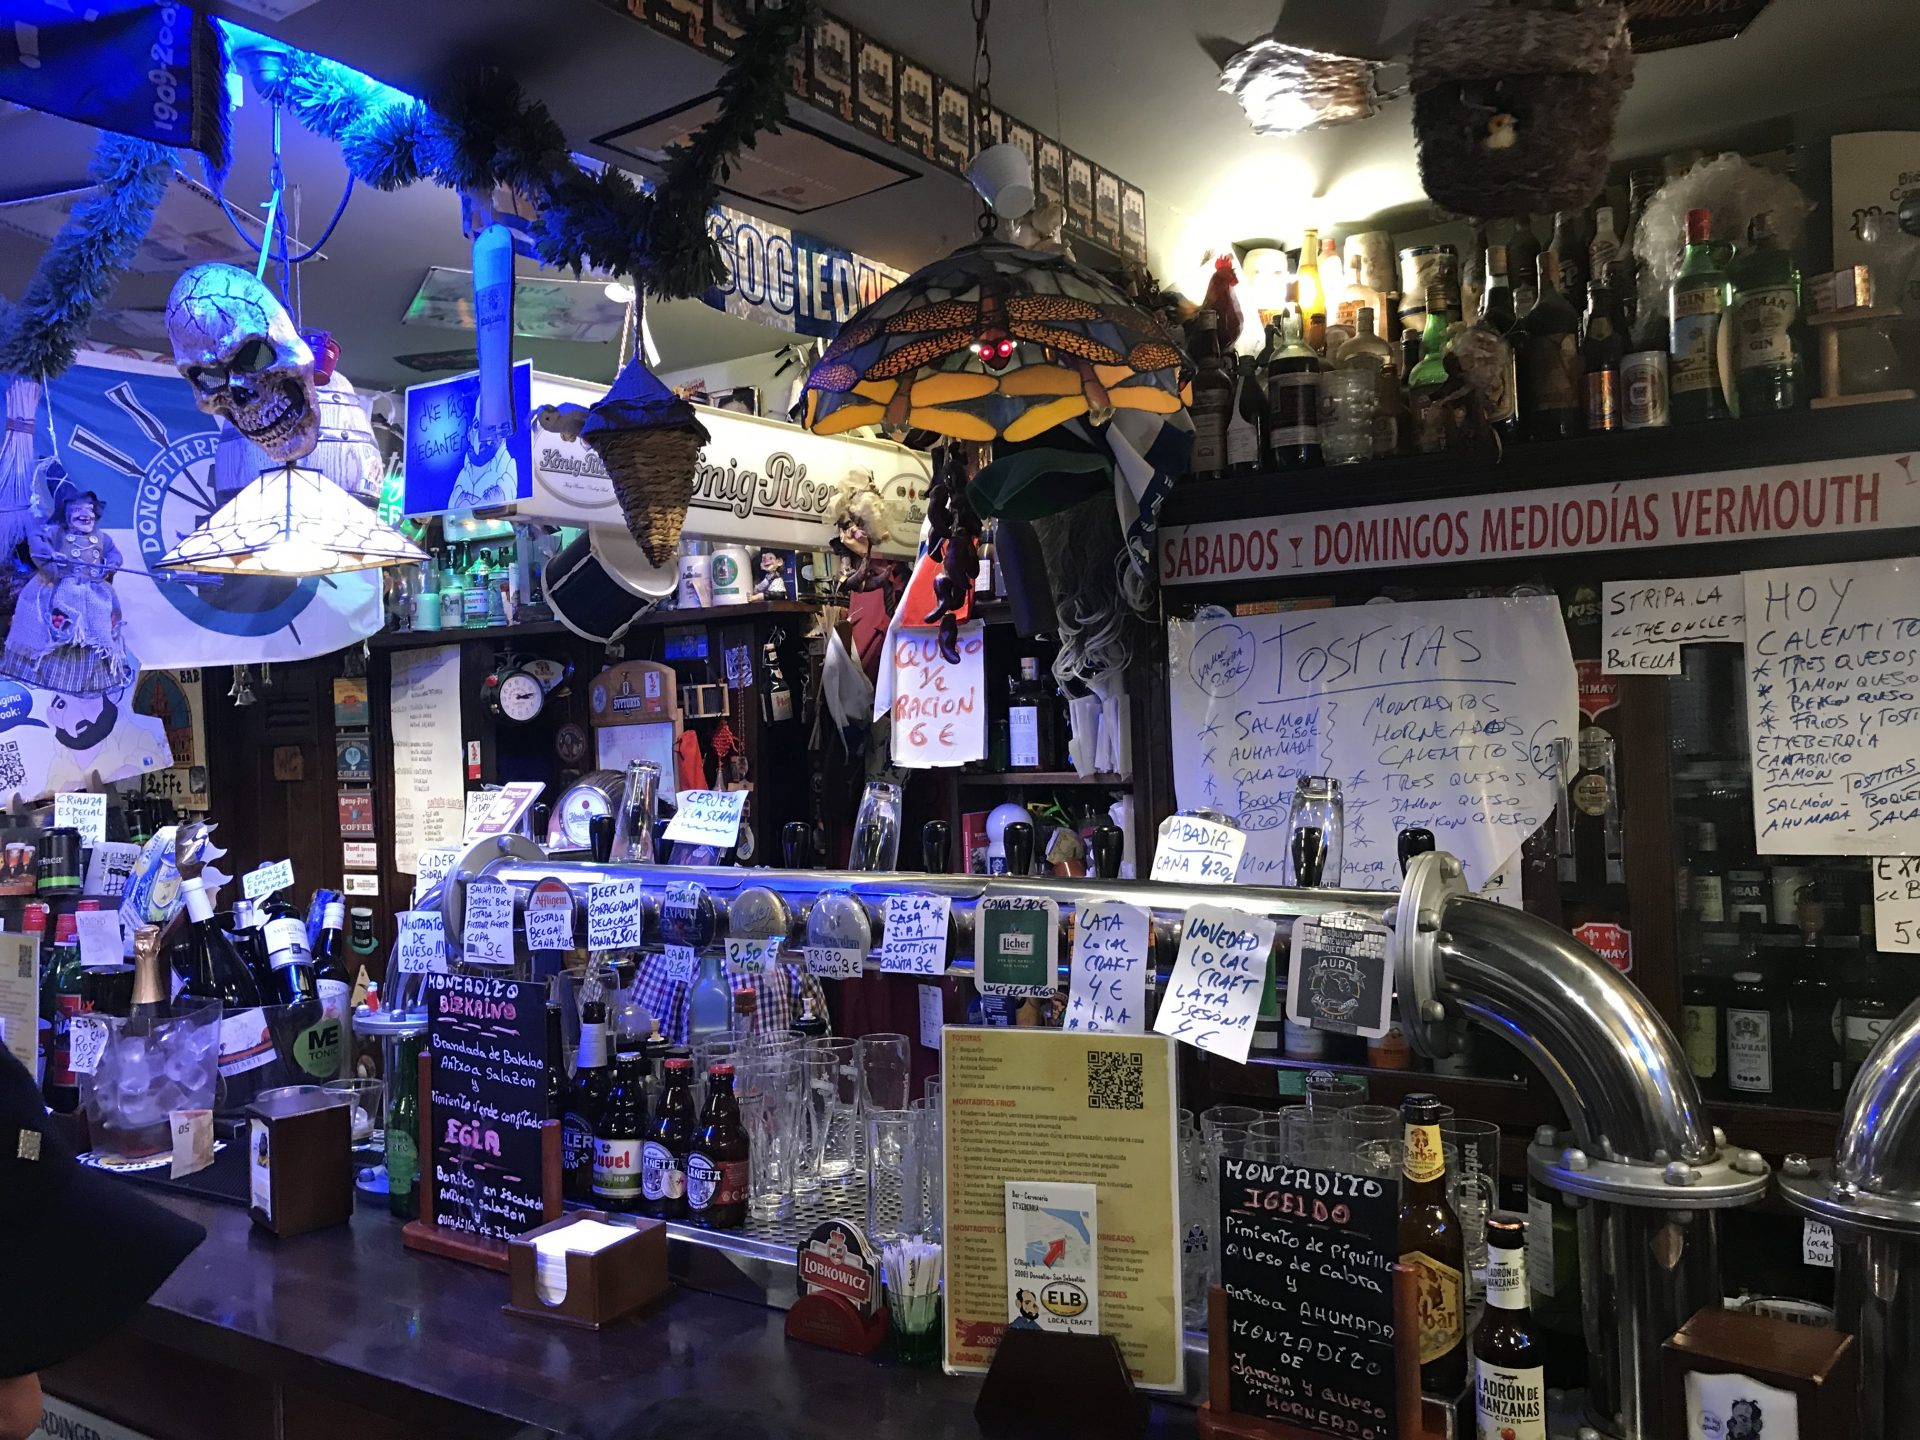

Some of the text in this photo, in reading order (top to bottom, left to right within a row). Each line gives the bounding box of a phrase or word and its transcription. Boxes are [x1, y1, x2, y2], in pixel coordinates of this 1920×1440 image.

[706, 213, 898, 322] SOCIEDA
[1164, 472, 1880, 579] SÁBADOS DOMINGOS MEDIODÍAS VERMOUTH
[1765, 577, 1854, 625] HOY
[1779, 650, 1918, 678] TRES QUESOS
[179, 671, 200, 684] BAR
[1857, 671, 1920, 687] QUESO
[147, 771, 183, 794] Leffe
[1383, 771, 1436, 792] TRES
[341, 823, 372, 831] COFFEE
[418, 854, 455, 867] CIDER
[470, 885, 508, 895] SALVATOR
[591, 885, 617, 903] BEER
[535, 895, 567, 907] Affligem
[890, 899, 930, 911] DE LA
[527, 912, 565, 925] TOSTADA
[889, 913, 921, 924] CASA
[1080, 909, 1124, 932] LATA
[412, 934, 425, 945] DE
[1186, 918, 1260, 952] NOVEDAD
[885, 942, 937, 955] SCOTTISH
[1003, 937, 1030, 951] Licher
[808, 949, 841, 962] TRIGO
[1320, 957, 1353, 971] AUPA
[1176, 984, 1229, 1008] LATA
[308, 1025, 340, 1049] ME
[433, 1033, 544, 1070] Brandada de Bakalao
[952, 1098, 1017, 1108] MONTADITOS FRIOS
[436, 1165, 476, 1189] Bonito
[613, 1175, 631, 1183] HOP
[1225, 1160, 1383, 1198] MONTADITO
[953, 1224, 997, 1234] MONTADITOS
[1225, 1215, 1300, 1249] Pimiento
[1305, 1235, 1323, 1253] de
[1226, 1243, 1283, 1267] Queso
[1289, 1255, 1311, 1273] de
[804, 1257, 866, 1291] LOBKOWICZ
[1512, 1268, 1520, 1277] DE
[1488, 1277, 1520, 1288] MANZANAS
[1047, 1290, 1082, 1307] ELB
[1047, 1317, 1093, 1327] LOCAL CRAFT
[1300, 1301, 1395, 1340] AHUMADA
[1232, 1318, 1382, 1376] MONTADITO
[1280, 1352, 1304, 1368] DE
[1478, 1378, 1539, 1401] LADRÓN DE
[1478, 1399, 1540, 1418] MANZANAS
[1495, 1415, 1522, 1425] CIDER
